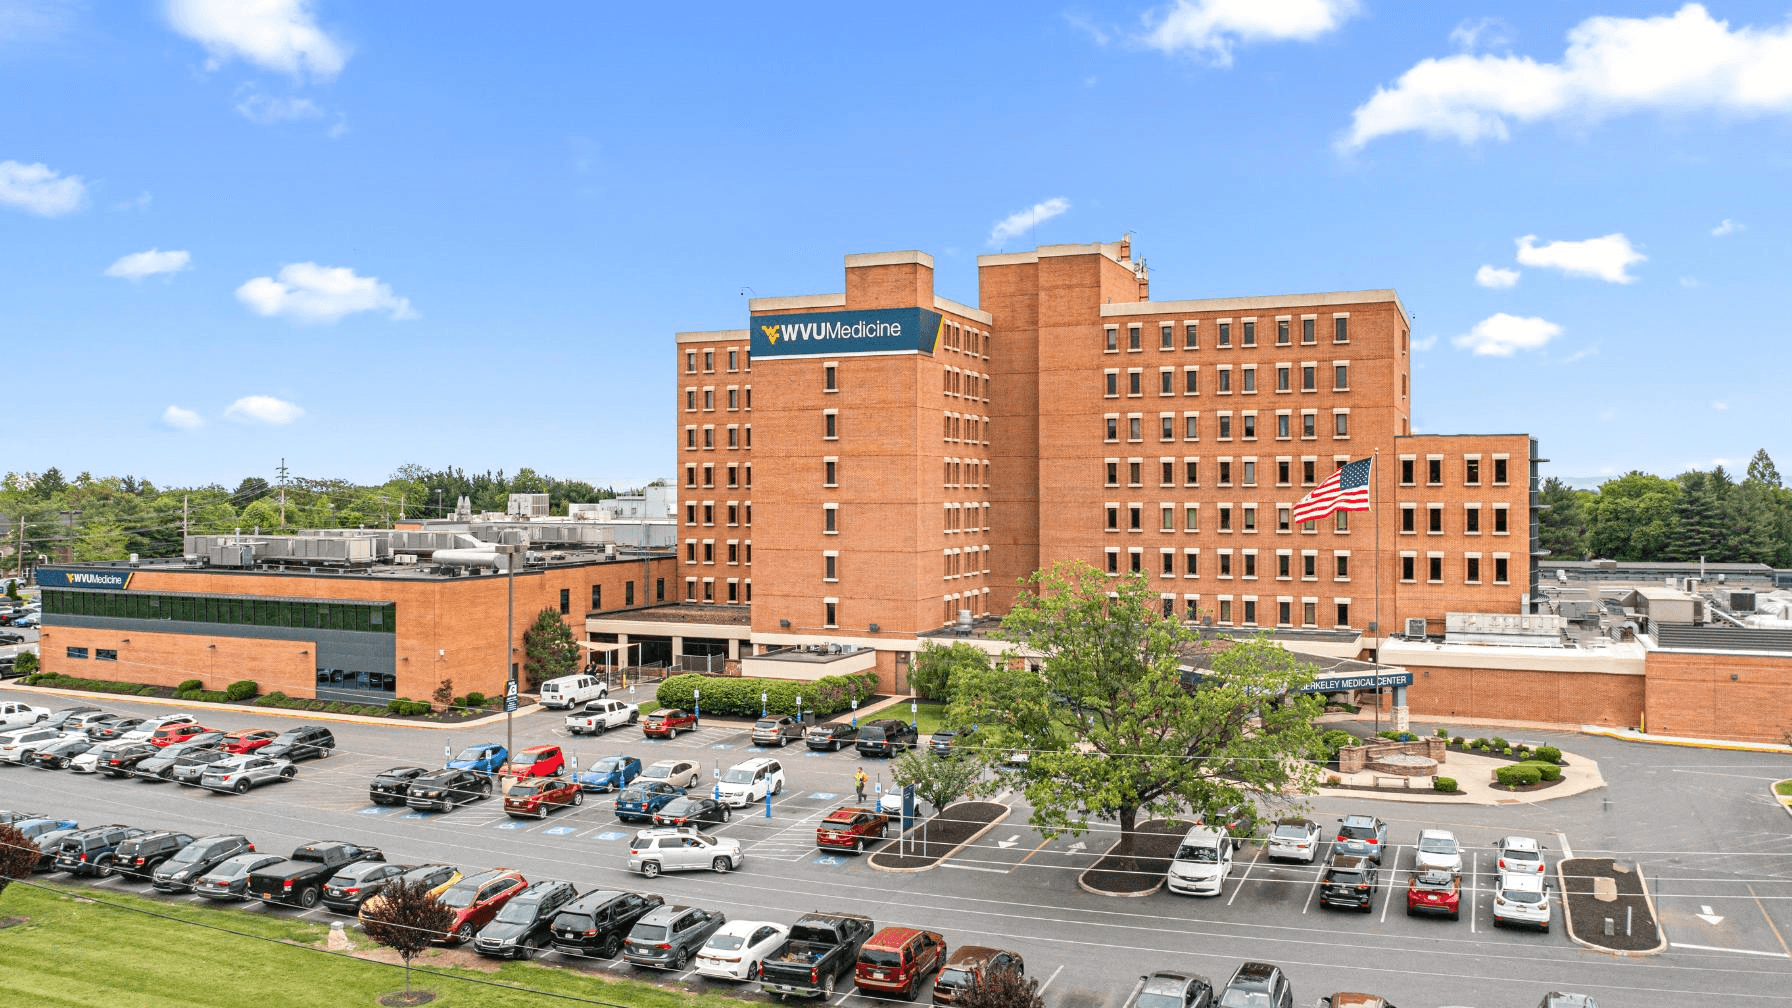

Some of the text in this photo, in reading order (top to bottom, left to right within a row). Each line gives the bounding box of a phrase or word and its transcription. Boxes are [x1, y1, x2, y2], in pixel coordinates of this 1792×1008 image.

[781, 320, 901, 341] WVUMedicine
[1342, 678, 1375, 688] MEDICAL
[1377, 675, 1407, 686] CENTER
